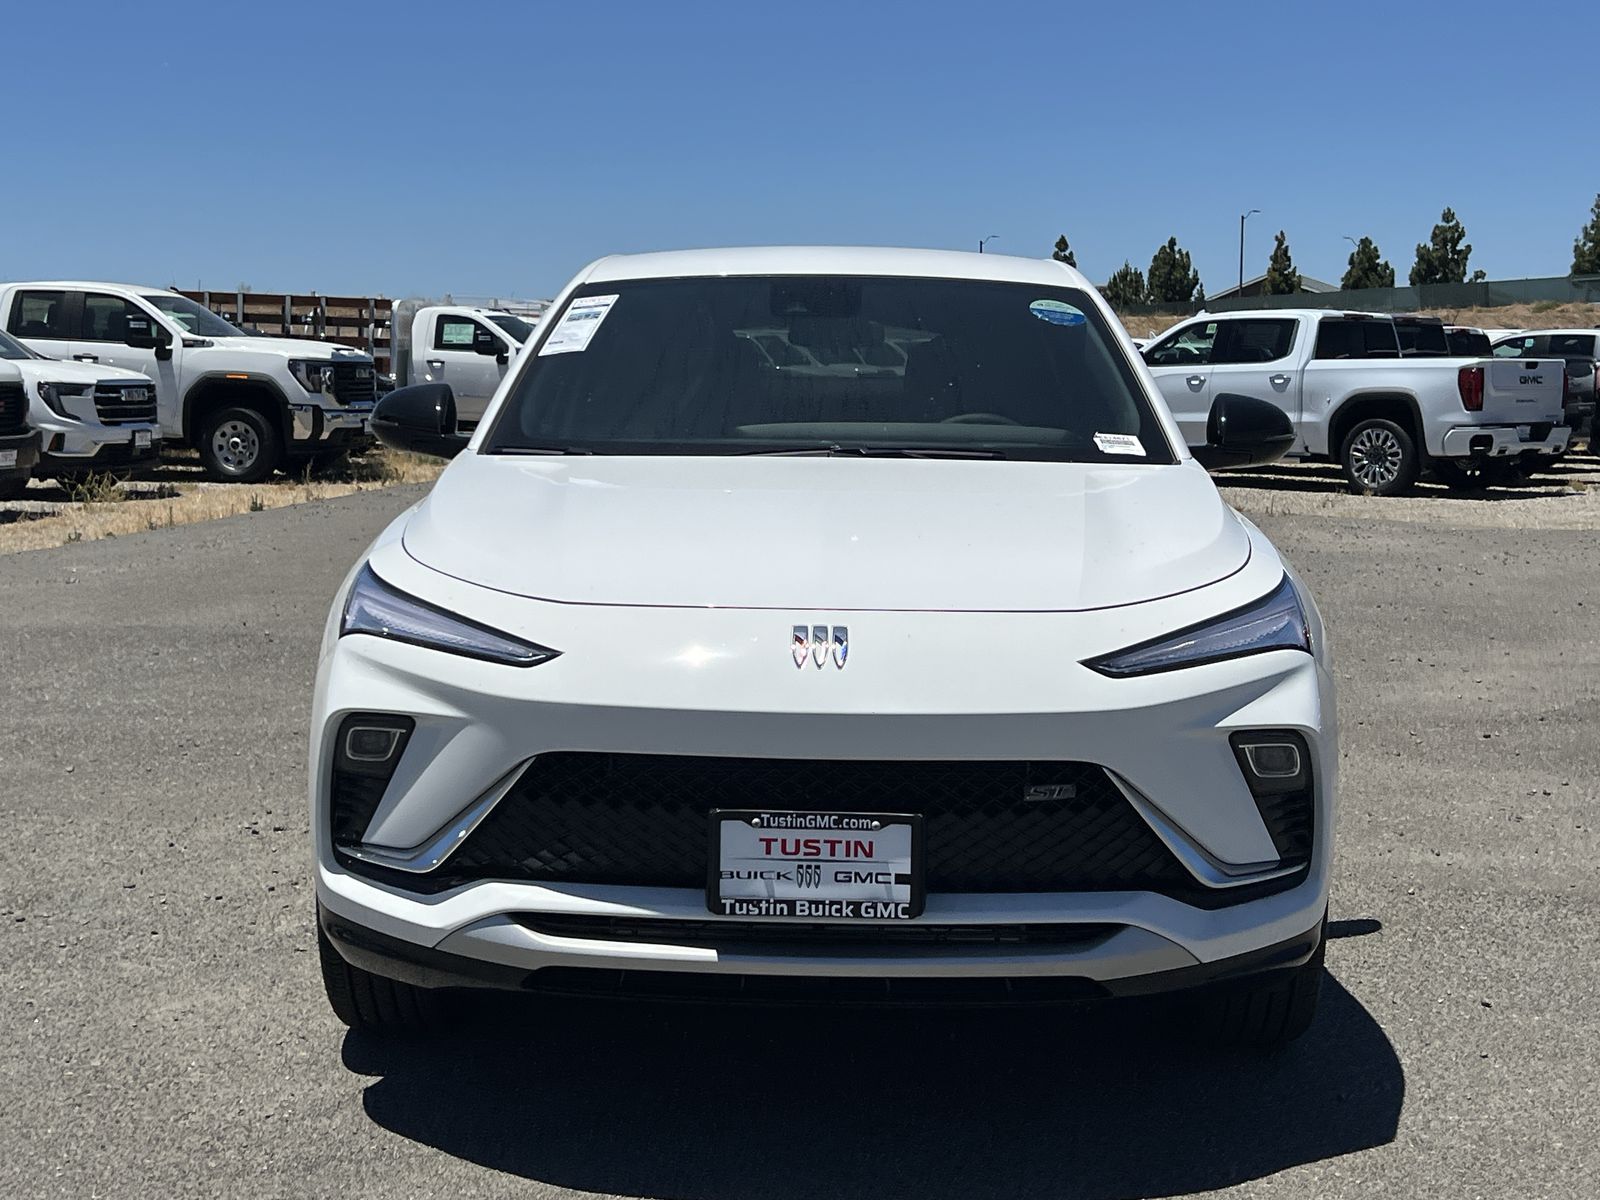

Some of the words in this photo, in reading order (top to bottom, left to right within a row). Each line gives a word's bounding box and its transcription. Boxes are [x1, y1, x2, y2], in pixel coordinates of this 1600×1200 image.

[1519, 376, 1543, 385] GMC
[761, 814, 872, 829] TustinGMC.com
[759, 838, 874, 858] TUSTIN
[720, 870, 793, 881] BUICK
[834, 871, 892, 884] GMC
[721, 899, 788, 916] Tustin
[796, 899, 853, 917] Buick
[861, 903, 910, 919] GMC
